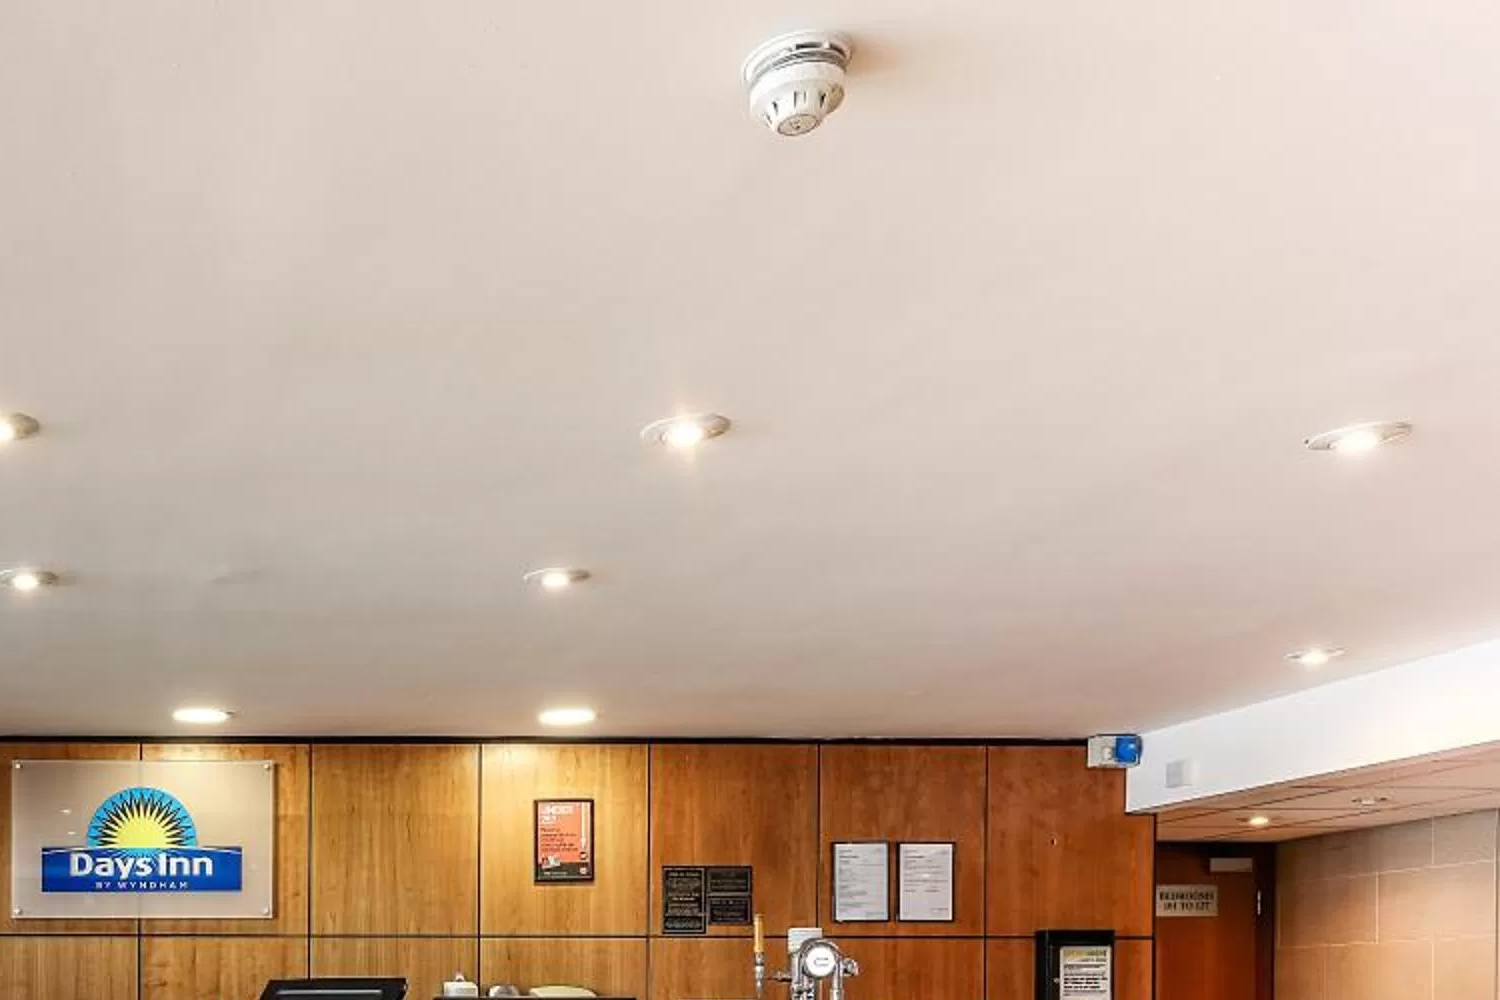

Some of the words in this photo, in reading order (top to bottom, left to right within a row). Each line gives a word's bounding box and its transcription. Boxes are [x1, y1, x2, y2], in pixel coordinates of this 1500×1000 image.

[70, 853, 152, 880] Days
[159, 853, 213, 876] Inn
[95, 881, 112, 889] BY
[117, 881, 189, 889] WYNDHAM
